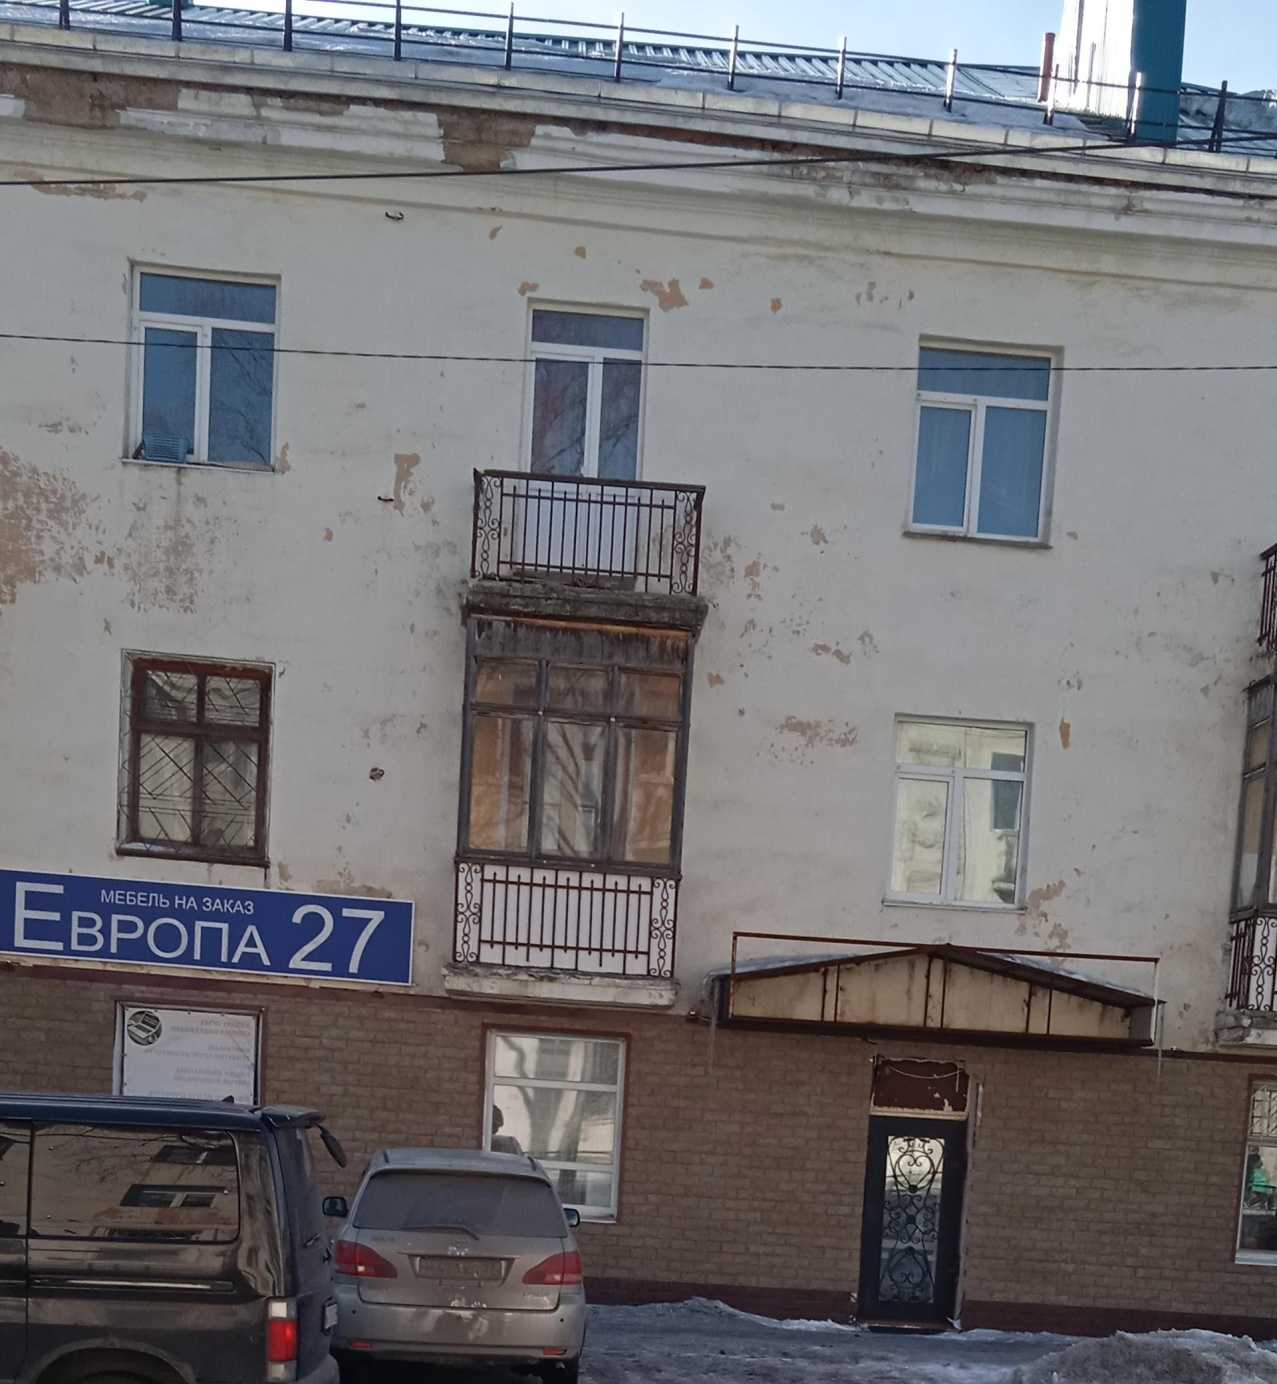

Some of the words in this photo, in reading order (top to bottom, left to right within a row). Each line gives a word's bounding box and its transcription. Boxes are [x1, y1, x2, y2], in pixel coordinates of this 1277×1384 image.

[13, 881, 271, 966] ЕВРОПА
[288, 904, 385, 974] 27
[100, 889, 169, 908] МЕБЕЛЬ
[174, 895, 198, 911] НА
[202, 897, 254, 915] ЗАКАЗ
